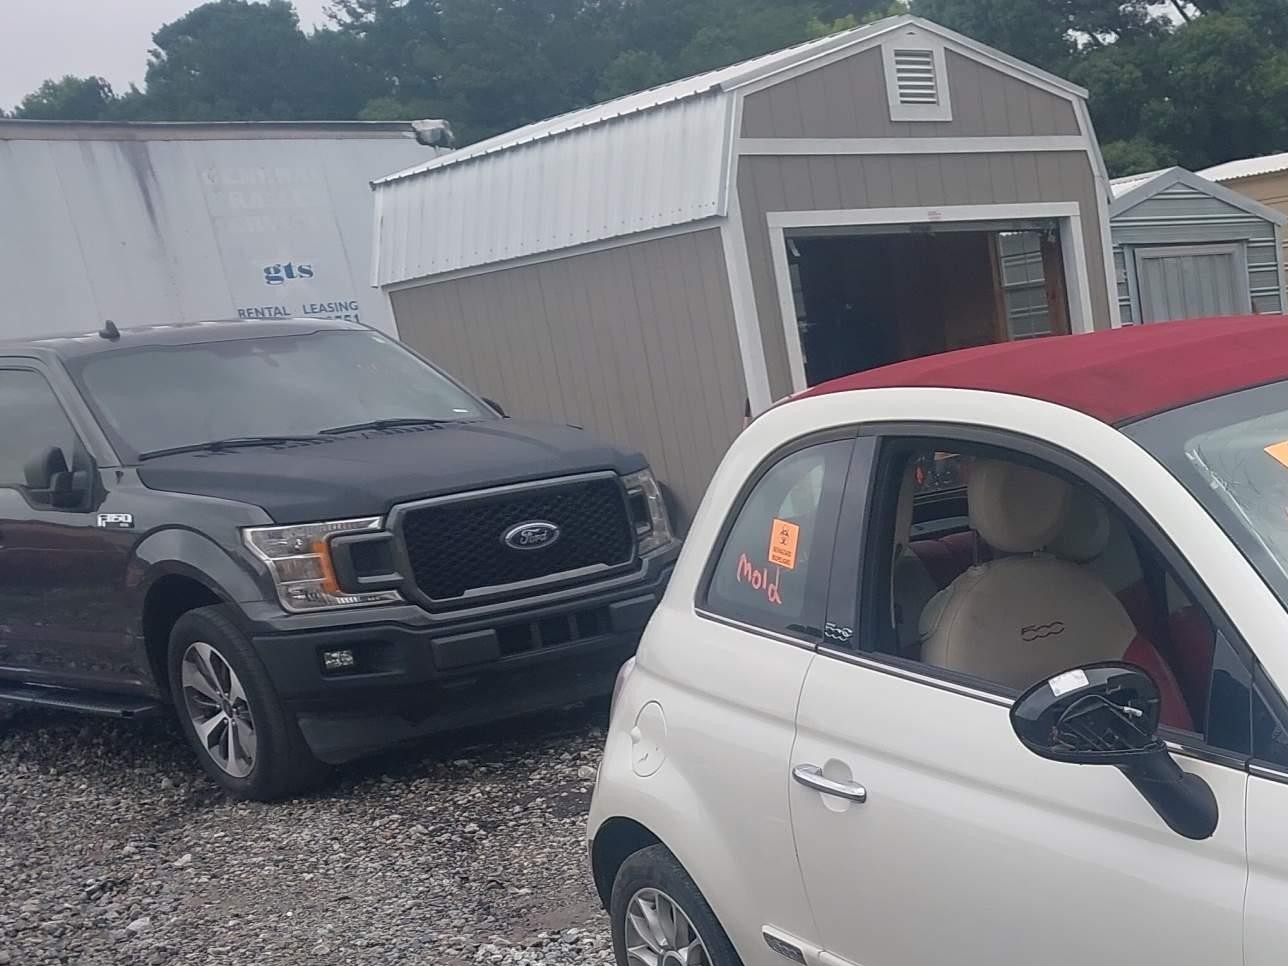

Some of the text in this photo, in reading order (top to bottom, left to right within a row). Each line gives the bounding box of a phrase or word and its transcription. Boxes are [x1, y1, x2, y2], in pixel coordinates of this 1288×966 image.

[263, 262, 314, 285] gts
[237, 301, 359, 319] RENTAL LEASING
[1021, 621, 1065, 641] 500
